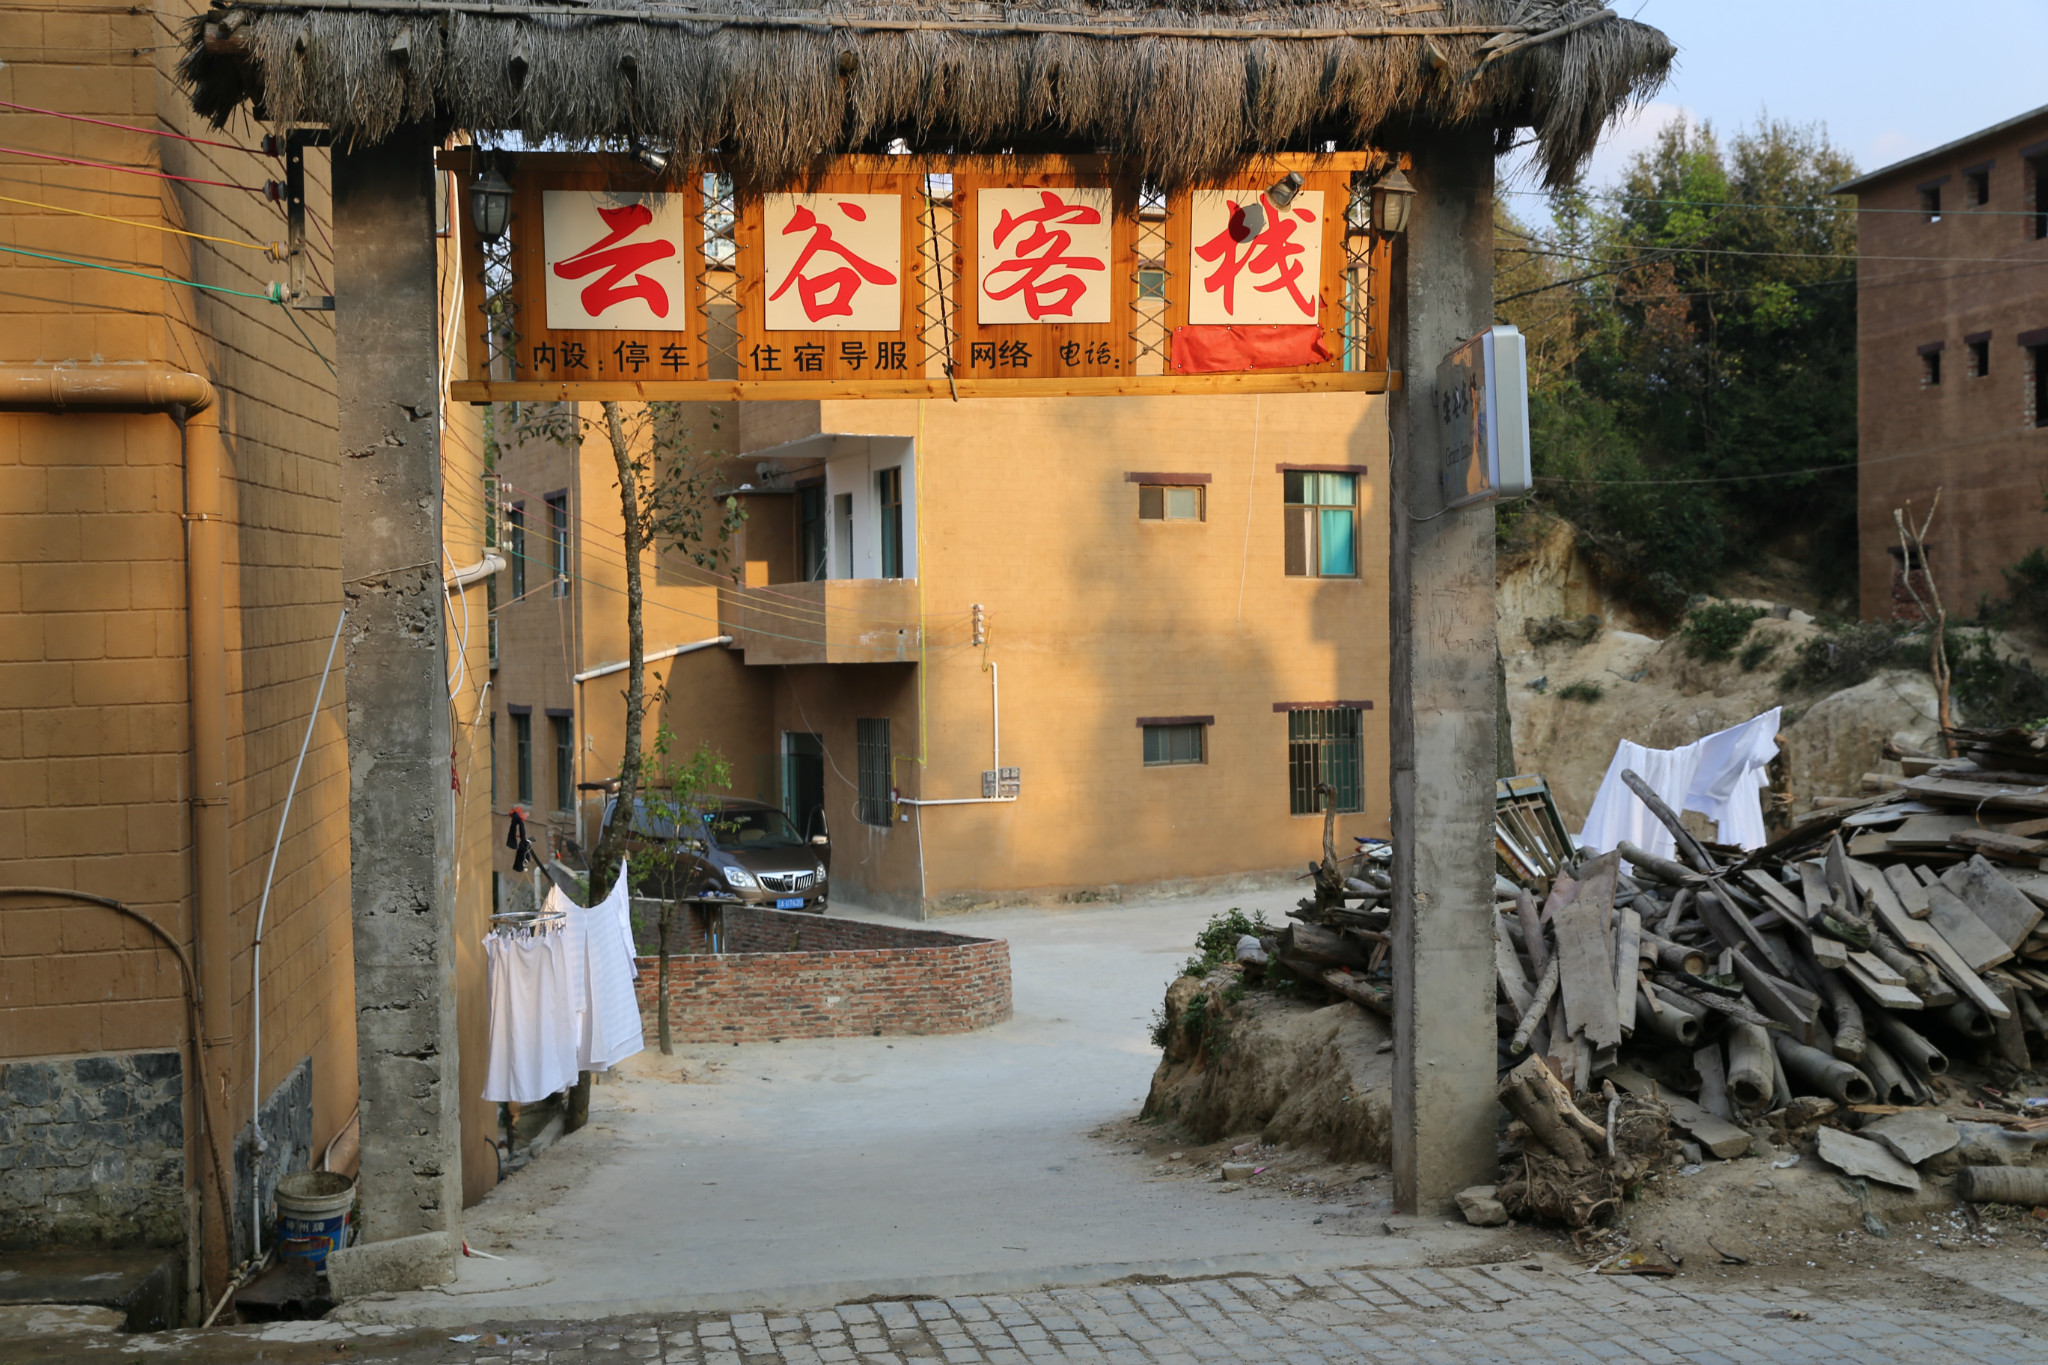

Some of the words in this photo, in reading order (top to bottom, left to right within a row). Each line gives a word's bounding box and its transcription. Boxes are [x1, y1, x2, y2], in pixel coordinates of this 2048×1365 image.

[553, 191, 1315, 322] 云谷客栈
[750, 341, 907, 372] 住宿导服
[971, 341, 1033, 369] 网络
